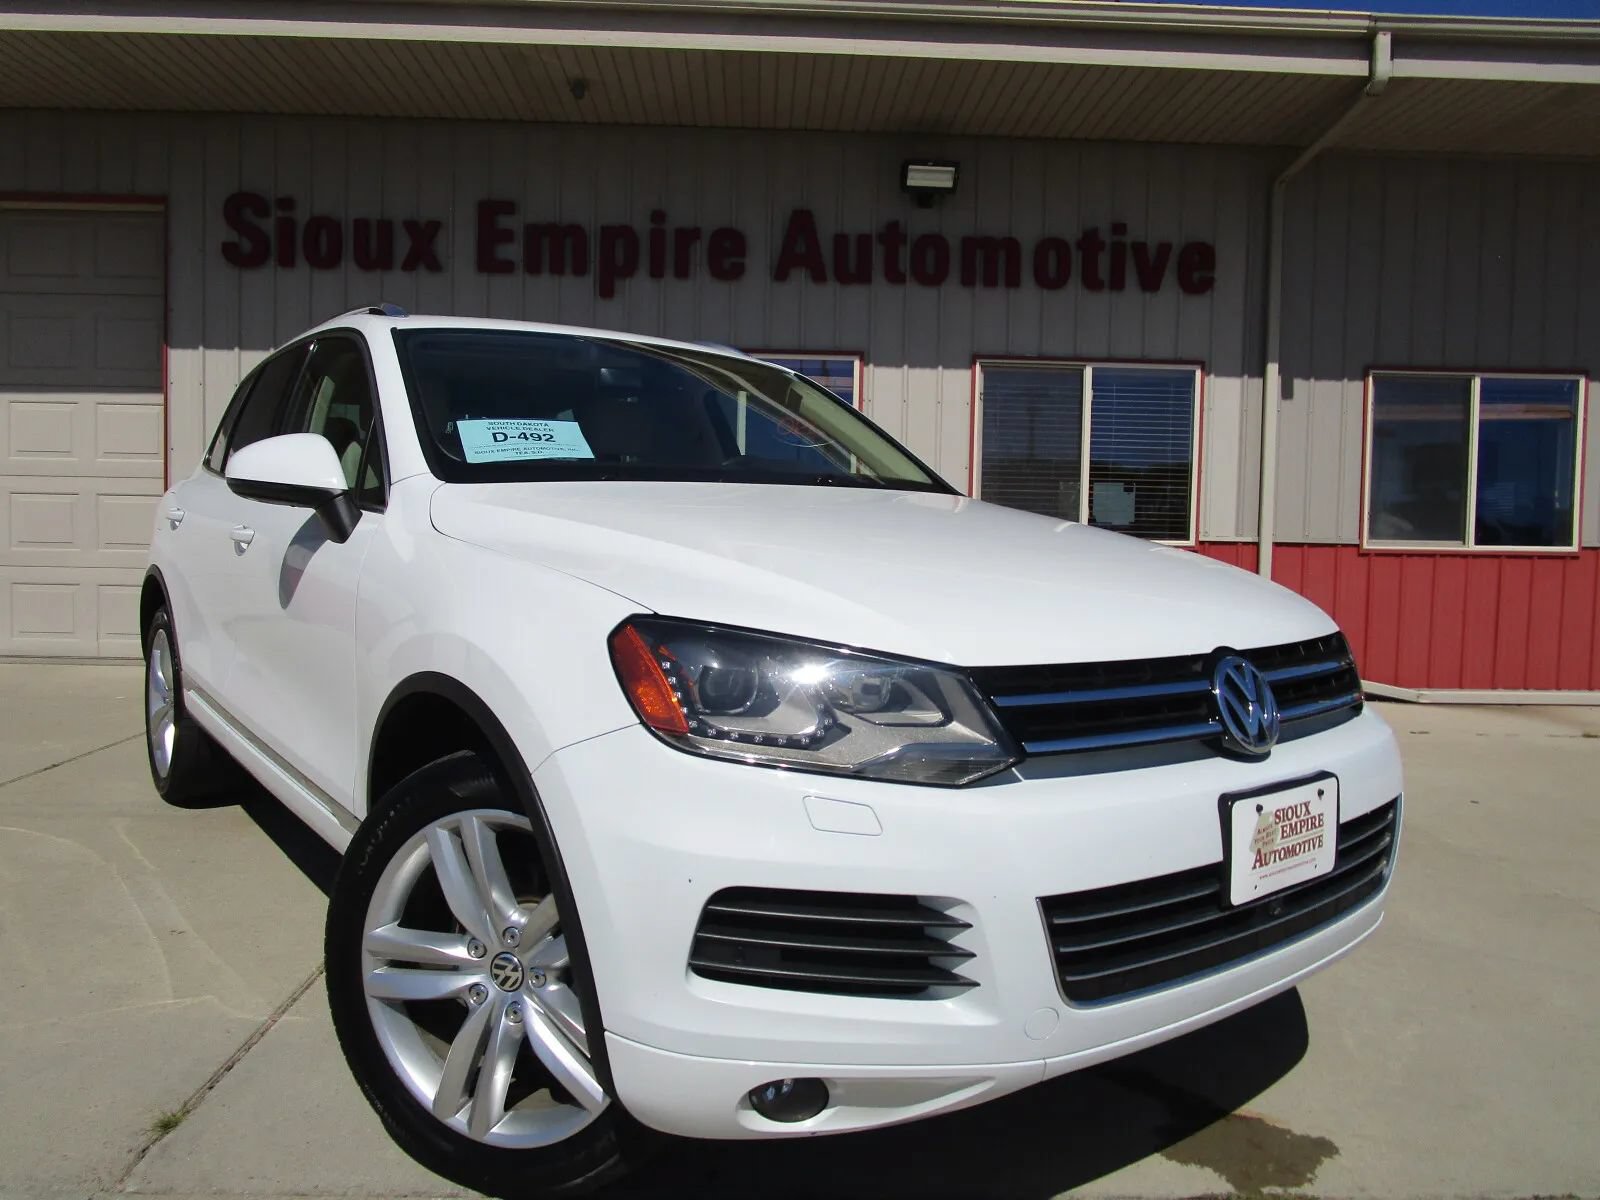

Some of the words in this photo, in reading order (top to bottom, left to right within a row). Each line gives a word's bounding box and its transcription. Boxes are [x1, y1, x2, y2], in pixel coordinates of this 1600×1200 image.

[221, 193, 443, 272] Sioux
[476, 200, 747, 299] Empire
[773, 208, 1217, 295] Automotive
[492, 432, 556, 443] D-492
[1274, 801, 1311, 824] SIOUX
[1280, 813, 1324, 840] EMPIRE
[1251, 834, 1324, 870] AUTOMOTIVE
